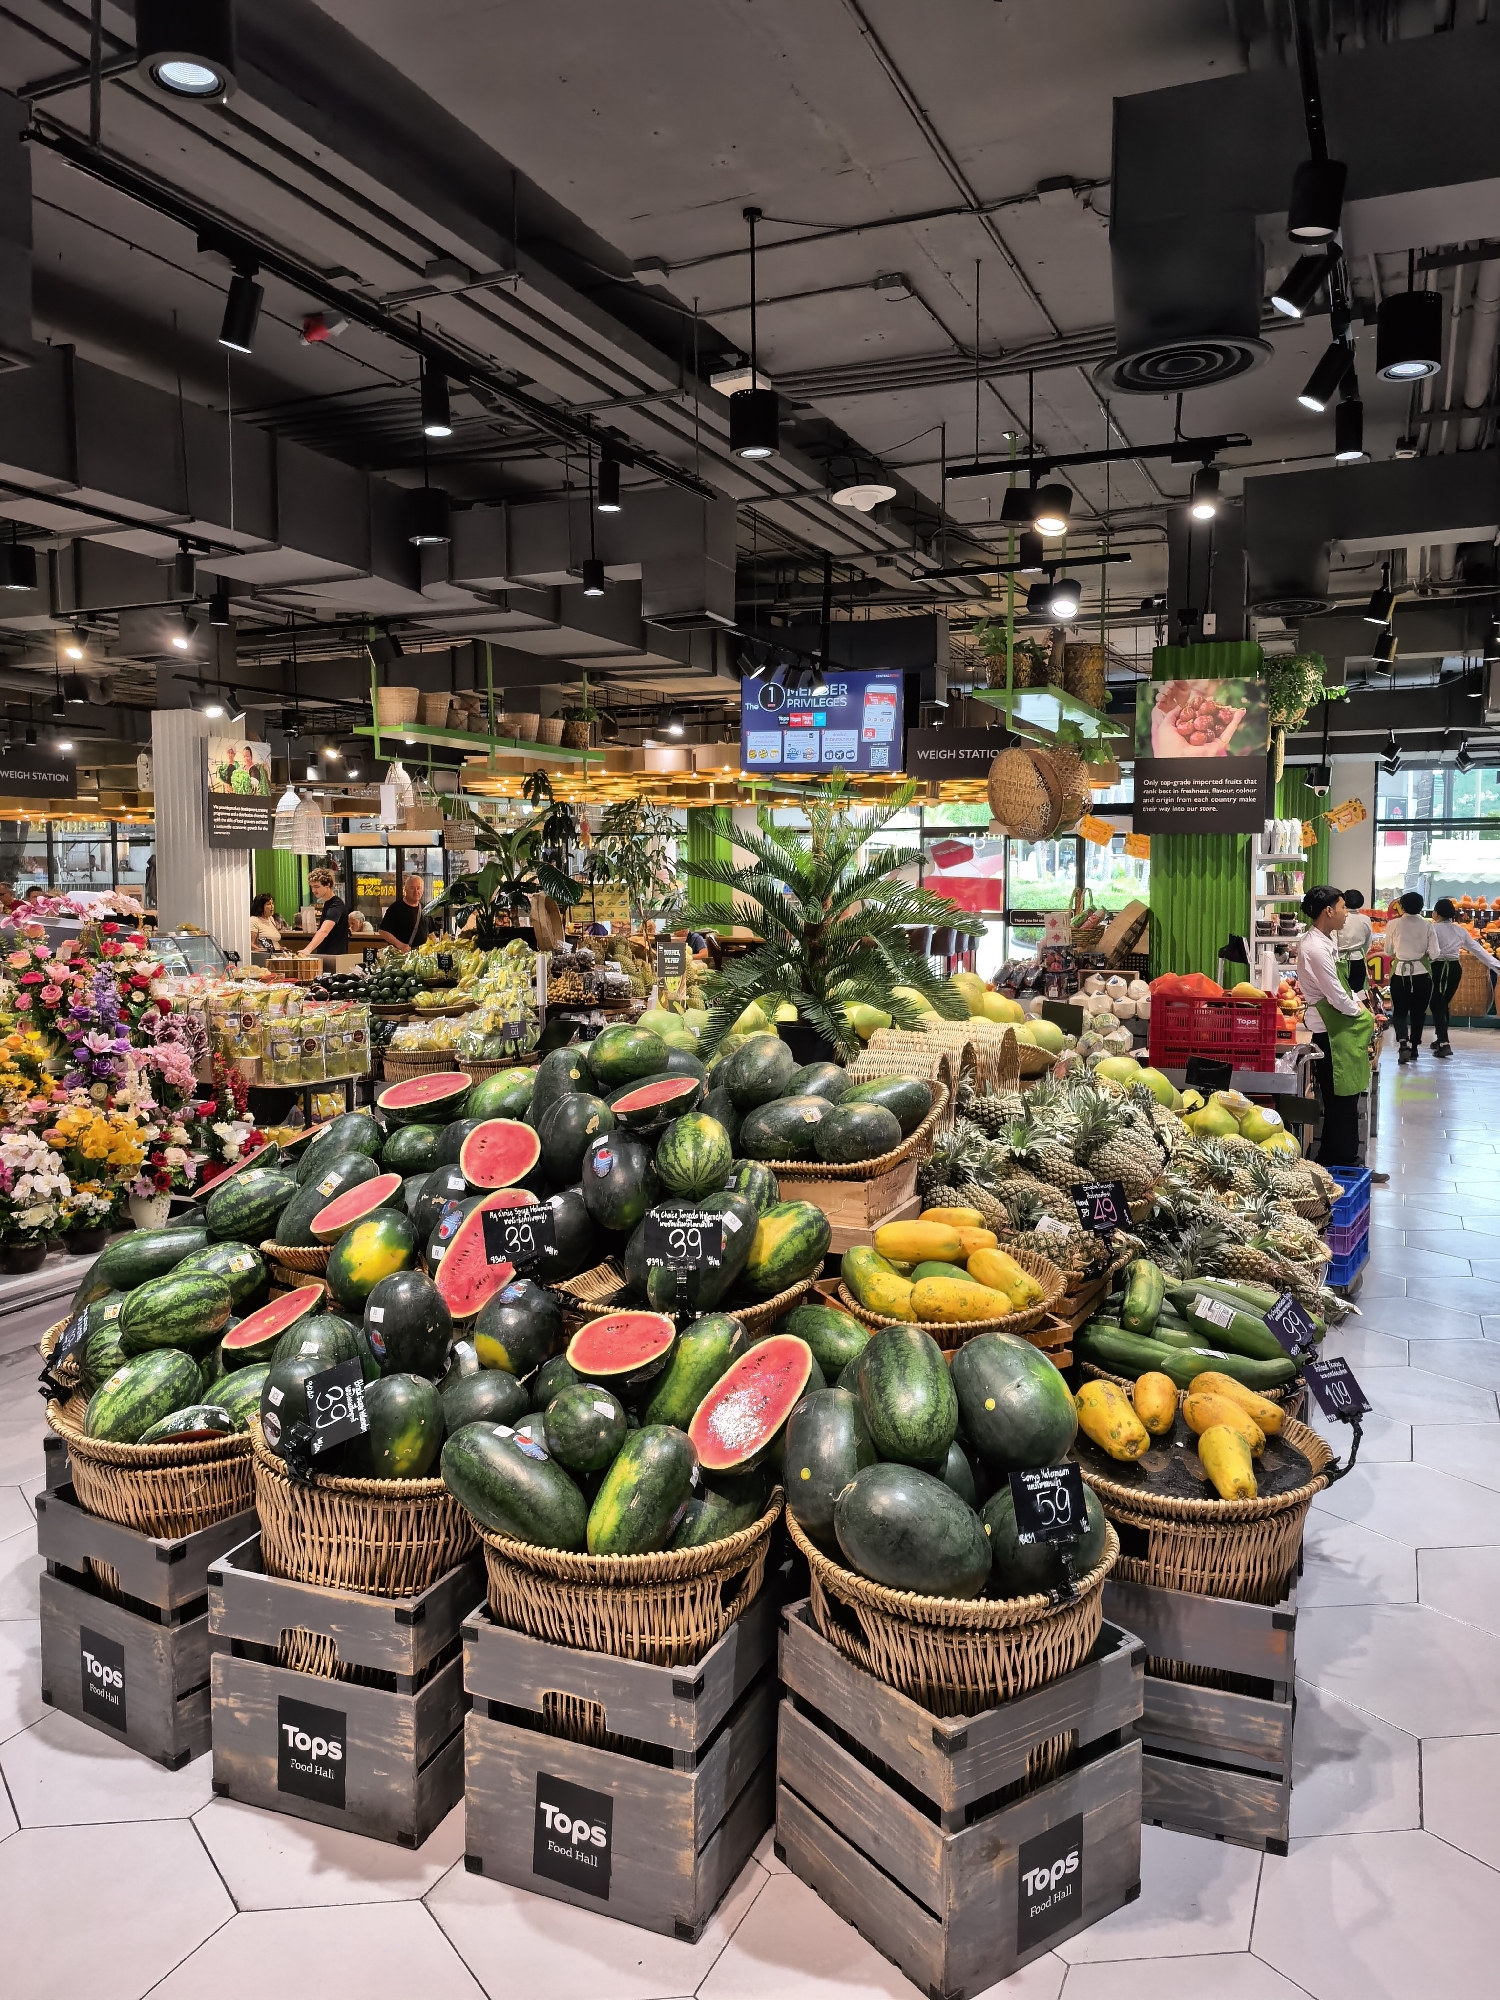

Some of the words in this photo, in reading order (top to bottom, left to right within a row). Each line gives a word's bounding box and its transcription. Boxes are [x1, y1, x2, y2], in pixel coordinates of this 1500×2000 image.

[787, 698, 847, 708] PRIVILEGES
[917, 750, 956, 760] WEIGH
[959, 749, 1001, 759] STATIO
[0, 771, 30, 780] WEIGH
[32, 771, 69, 782] STATION
[1143, 779, 1158, 787] Only
[1161, 779, 1191, 787] top-grade
[1237, 1018, 1257, 1026] Tops
[1094, 1198, 1118, 1222] 49
[504, 1223, 535, 1254] 39
[666, 1228, 703, 1260] 39
[1282, 1310, 1308, 1342] 99
[315, 1386, 347, 1429] 39
[1325, 1380, 1352, 1407] 109
[1036, 1487, 1072, 1526] 59
[83, 1650, 123, 1689] Tops
[89, 1682, 105, 1699] Food
[105, 1687, 119, 1706] Hall
[282, 1723, 343, 1761] Tops
[290, 1758, 313, 1774] Food
[314, 1763, 335, 1781] Hall
[540, 1801, 607, 1848] Tops
[548, 1840, 573, 1858] Food
[575, 1850, 598, 1868] Hall
[1022, 1850, 1079, 1897] Tops
[1029, 1895, 1052, 1918] Food
[1053, 1884, 1073, 1904] Hall
